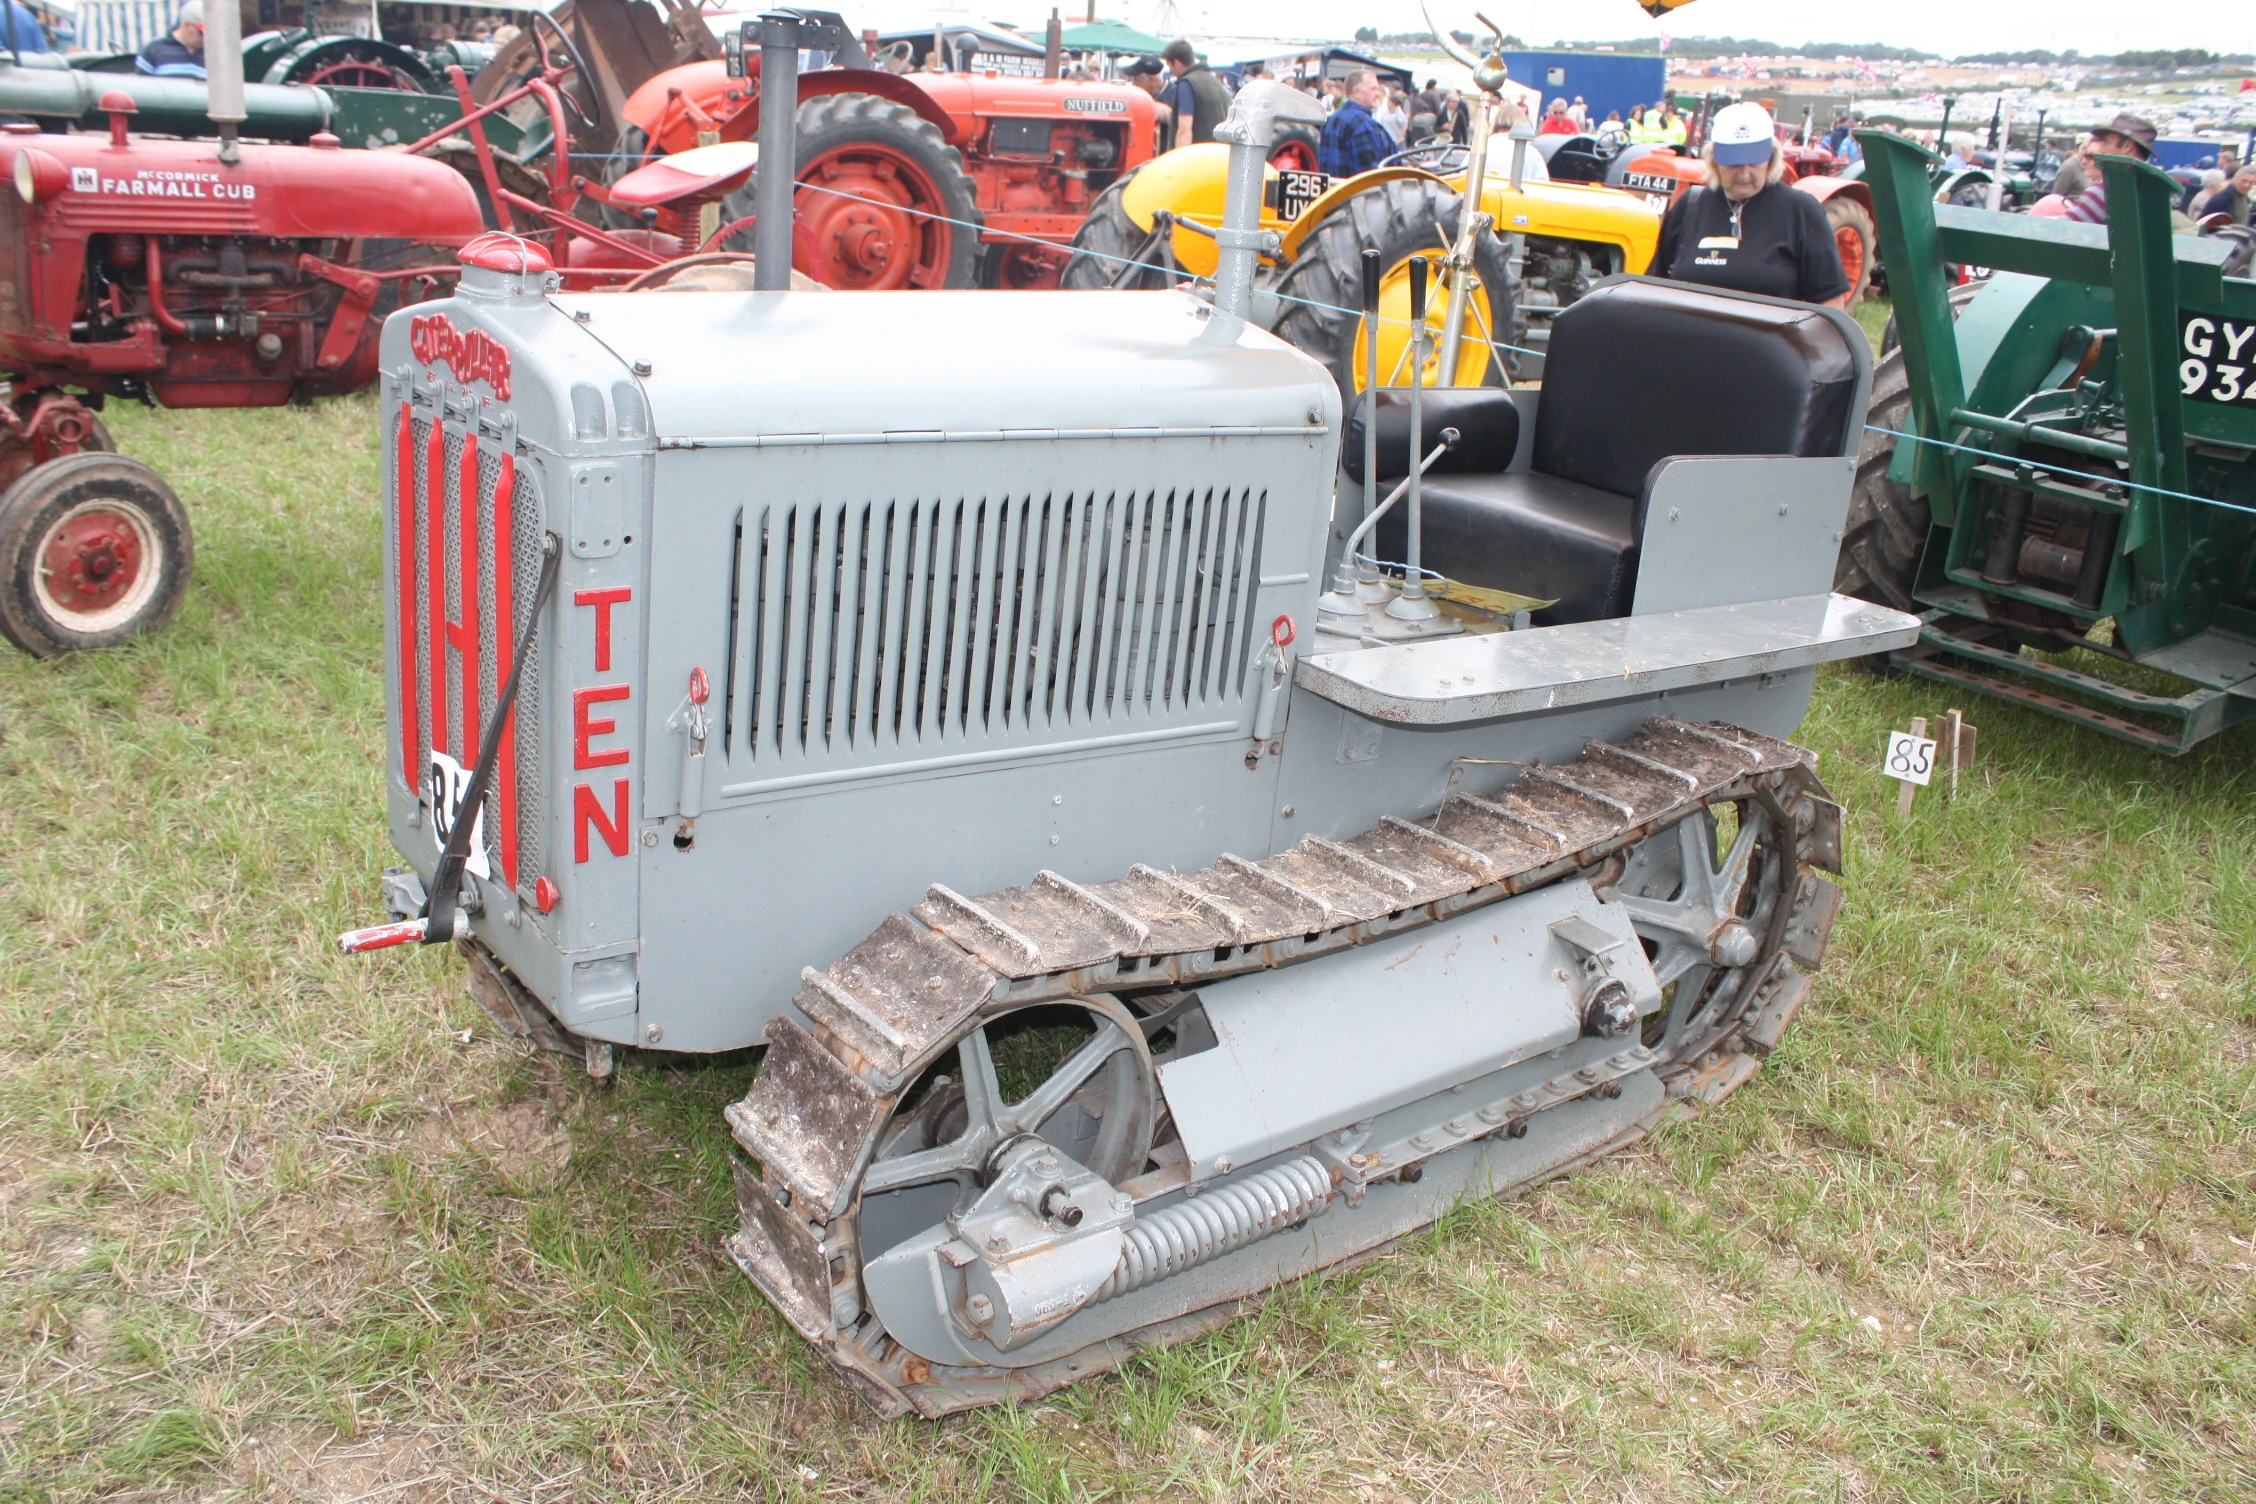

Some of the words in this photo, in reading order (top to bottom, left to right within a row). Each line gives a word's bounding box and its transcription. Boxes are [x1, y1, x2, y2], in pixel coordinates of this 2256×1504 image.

[1066, 98, 1125, 113] NUFFIELD
[102, 178, 207, 199] FARMALL
[212, 184, 256, 200] CUB
[1286, 173, 1322, 198] 296
[1629, 173, 1651, 188] FTA
[1652, 175, 1669, 190] 44
[1694, 256, 1728, 266] GUINNESS
[2184, 317, 2256, 364] GY
[573, 586, 632, 864] TEN
[1891, 738, 1934, 775] 85
